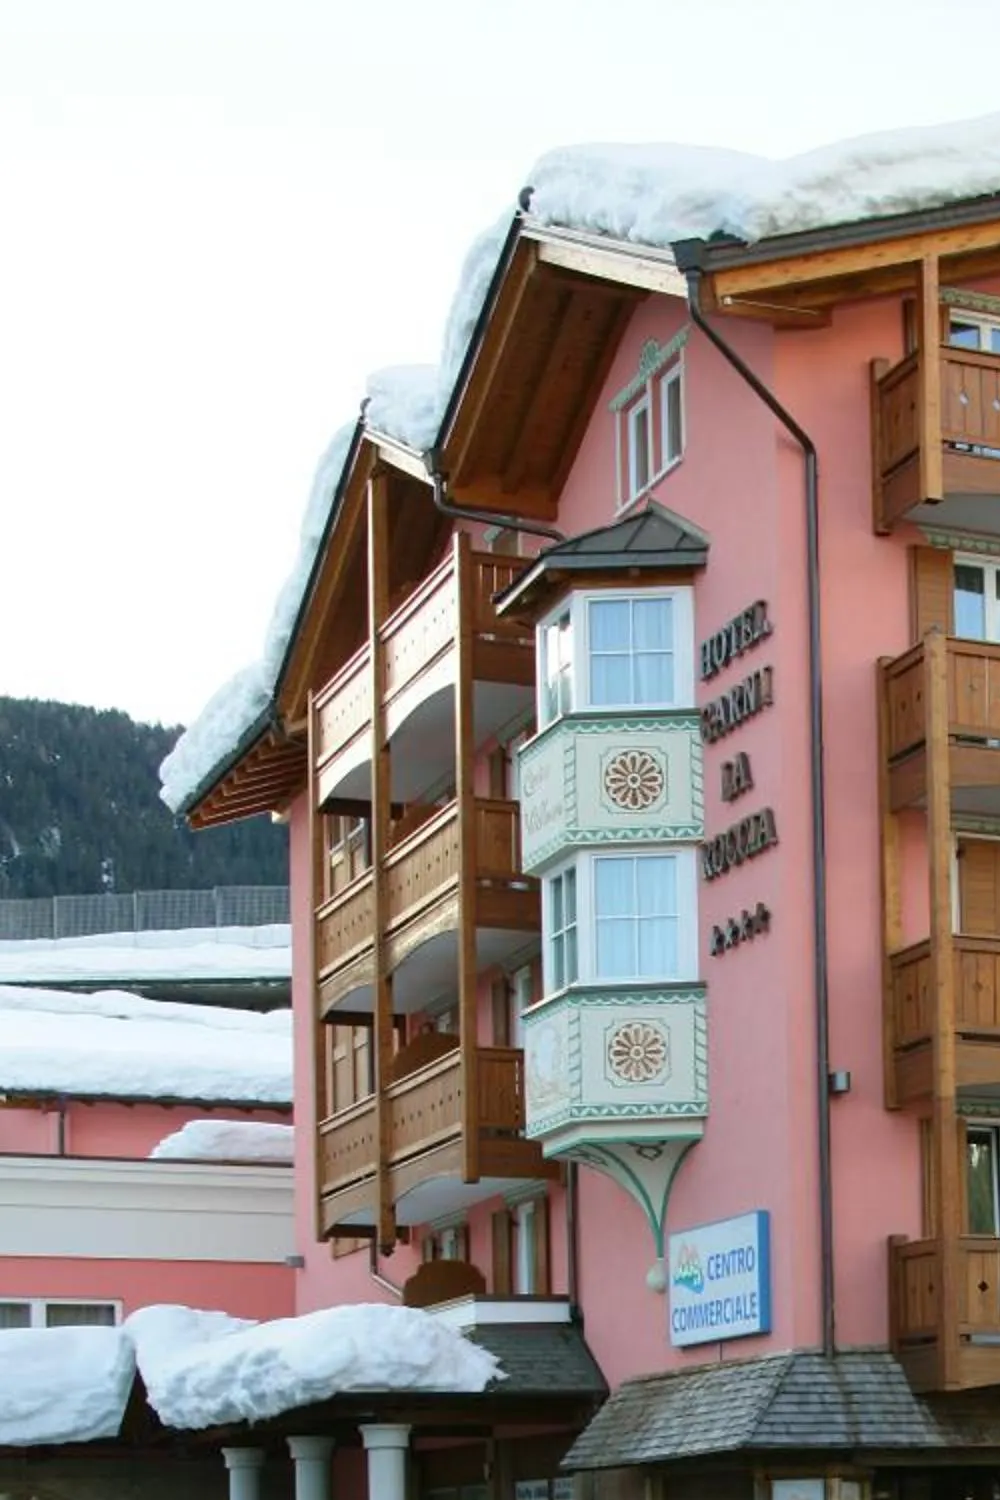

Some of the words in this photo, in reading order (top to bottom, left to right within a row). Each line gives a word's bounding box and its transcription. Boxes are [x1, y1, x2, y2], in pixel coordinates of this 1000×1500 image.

[701, 600, 772, 680] HOTEL
[701, 665, 774, 744] GARNI
[721, 751, 753, 801] LA
[707, 1246, 756, 1280] CENTRO
[672, 1291, 758, 1333] COMMERCIALE
